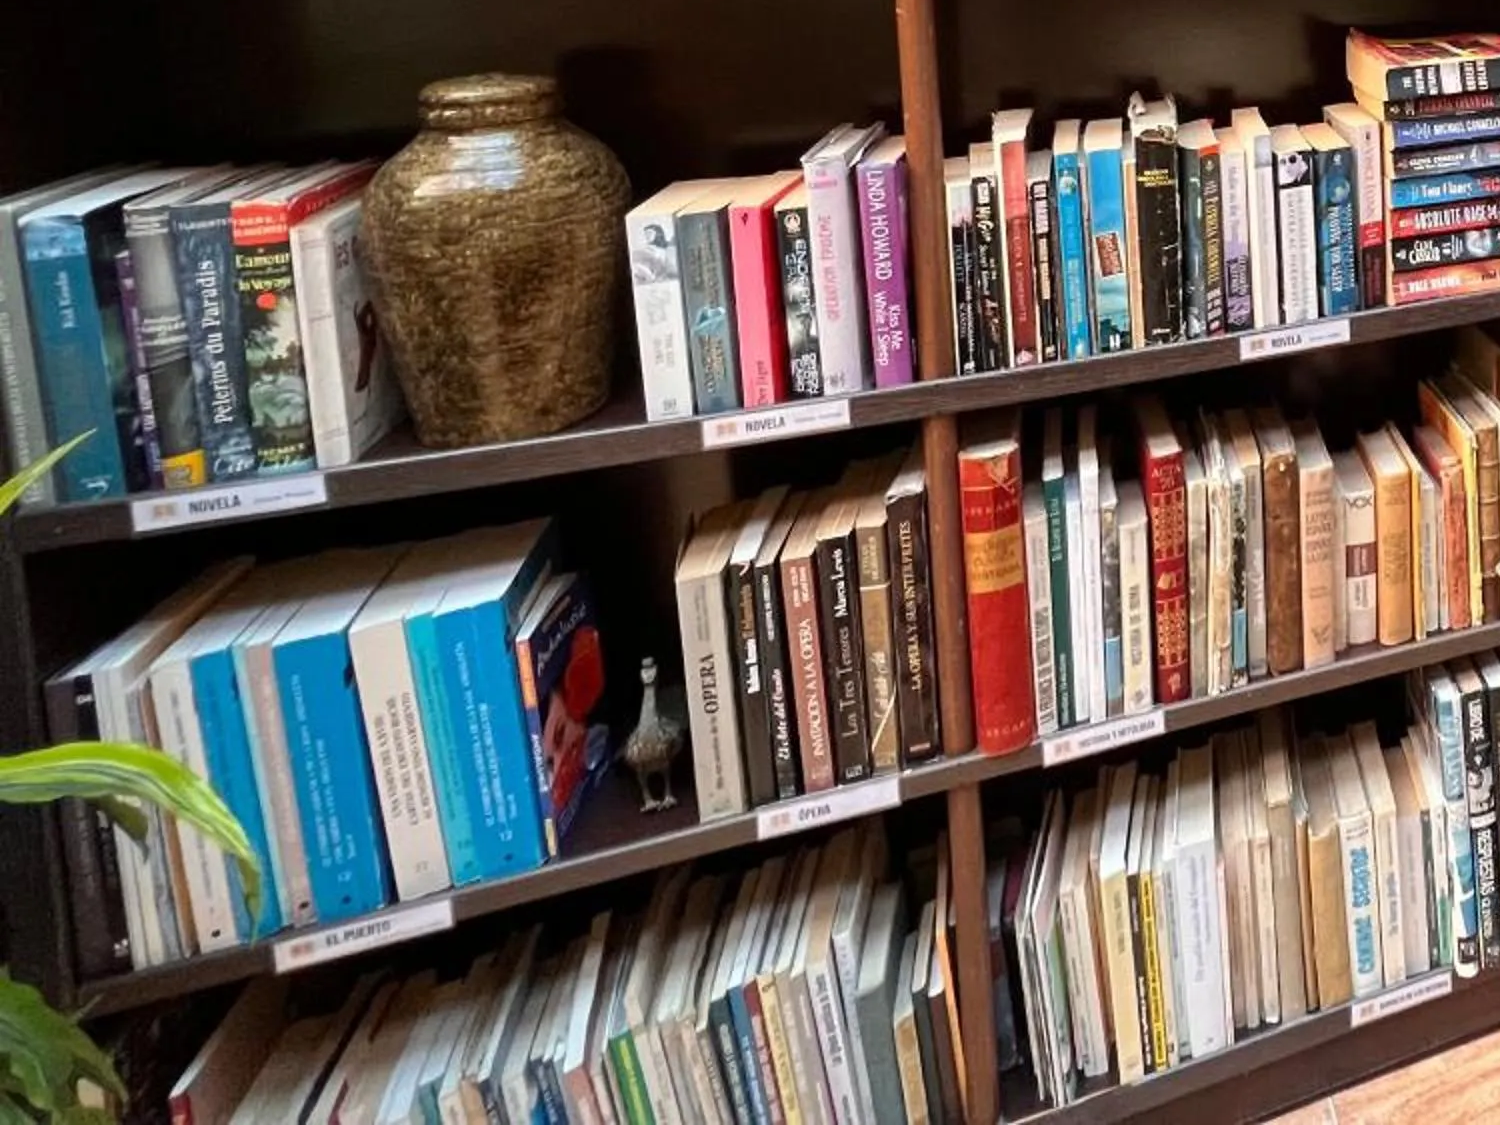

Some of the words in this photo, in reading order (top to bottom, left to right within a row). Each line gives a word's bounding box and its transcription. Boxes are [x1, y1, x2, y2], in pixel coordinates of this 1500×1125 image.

[866, 170, 886, 212] LINDA
[1416, 206, 1461, 229] ABSOLUTE
[869, 215, 893, 280] HOWARD
[195, 259, 220, 329] Paradis
[873, 290, 888, 326] While
[889, 304, 901, 328] Kiss
[204, 332, 223, 354] du
[877, 334, 891, 366] Sleep
[891, 330, 904, 350] Me
[1271, 334, 1302, 348] NOVELA
[745, 416, 786, 433] NOVELA
[189, 494, 241, 514] NOVELA
[830, 548, 844, 578] Lewis
[898, 521, 915, 603] INTERPRETES
[834, 579, 849, 618] Marcia
[904, 603, 916, 622] SUS
[798, 618, 816, 659] OPERA
[835, 626, 854, 675] Tenores
[907, 635, 921, 672] OPERA
[699, 653, 720, 714] OPERA
[804, 661, 816, 678] LA
[908, 672, 921, 691] LA
[806, 681, 817, 690] A
[839, 679, 856, 708] Tres
[774, 702, 786, 719] del
[1476, 828, 1495, 895] RESPUESTAS
